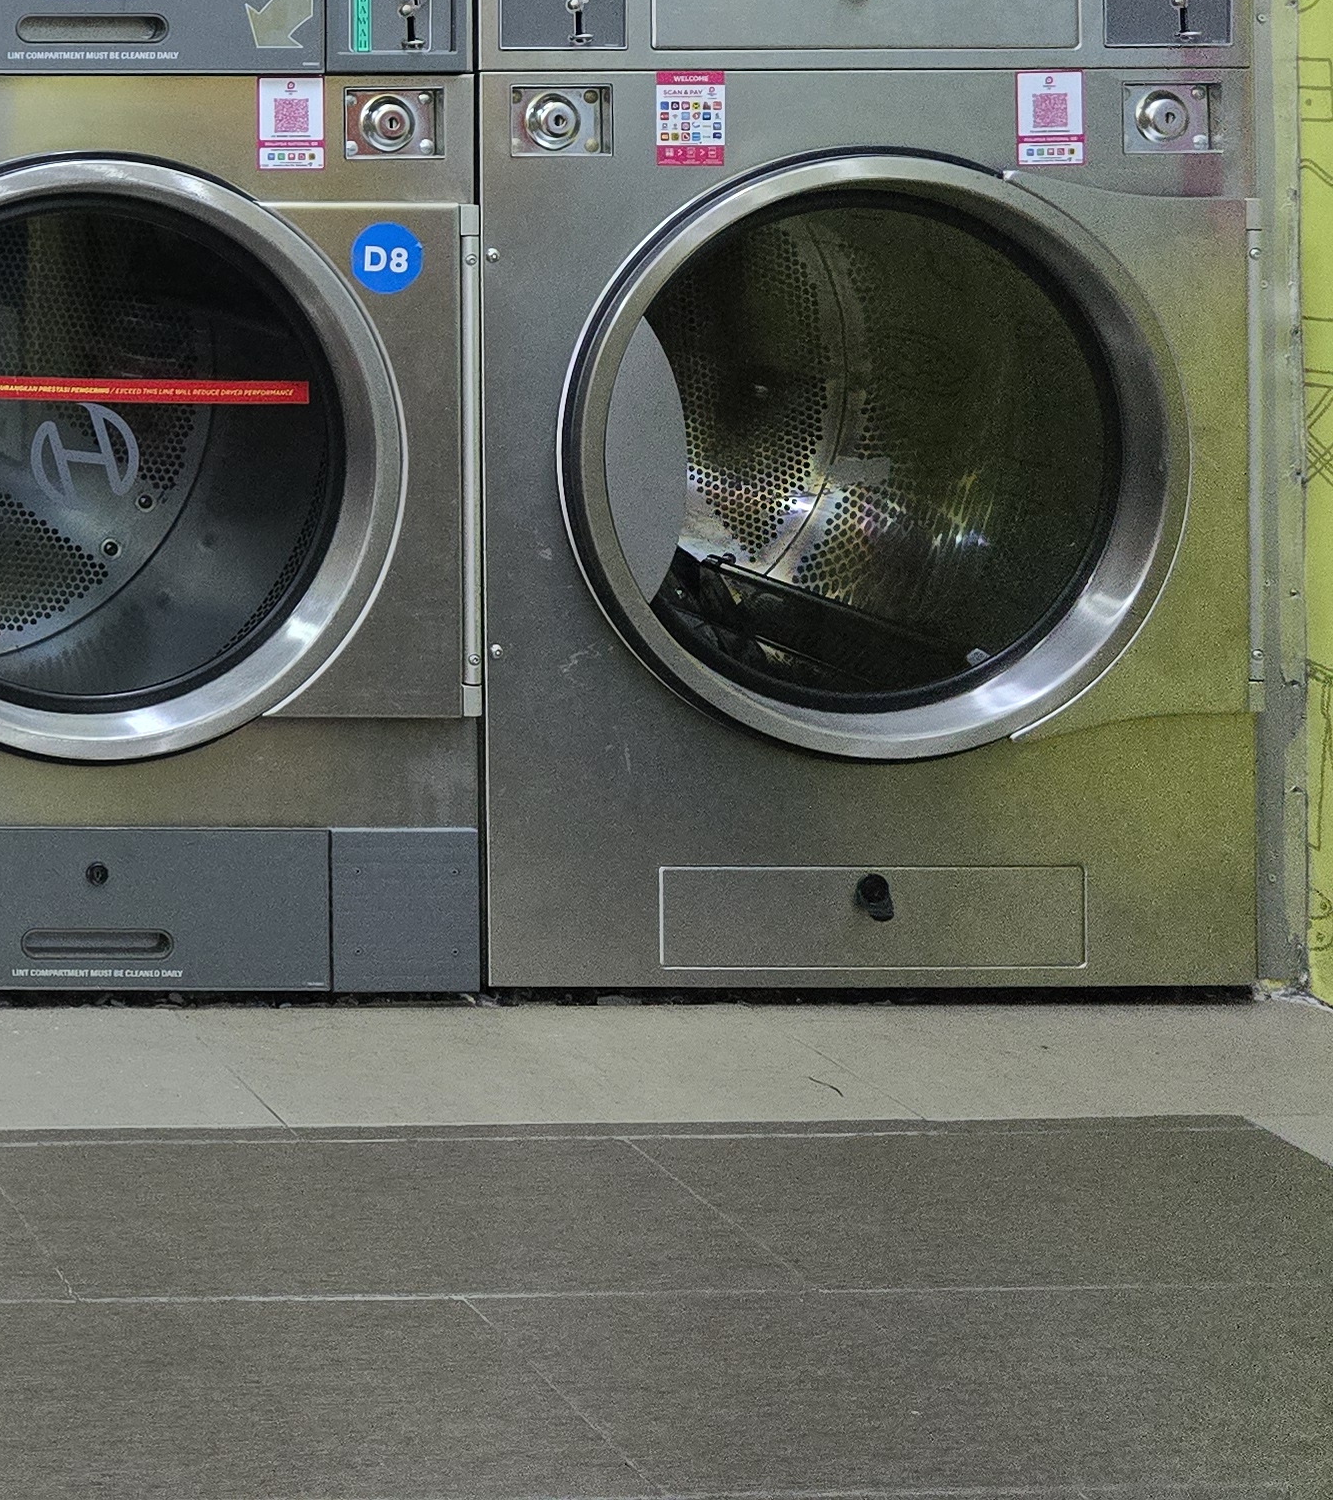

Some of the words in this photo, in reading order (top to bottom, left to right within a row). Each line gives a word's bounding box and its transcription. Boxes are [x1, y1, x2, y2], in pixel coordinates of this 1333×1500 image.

[7, 51, 24, 60] LINT
[26, 51, 85, 60] COMPARTMENT
[86, 51, 108, 60] MUST
[110, 51, 120, 60] BE
[121, 51, 156, 60] CLEANED
[157, 51, 179, 60] DAILY
[673, 74, 709, 82] WELCOME
[364, 245, 409, 273] D8
